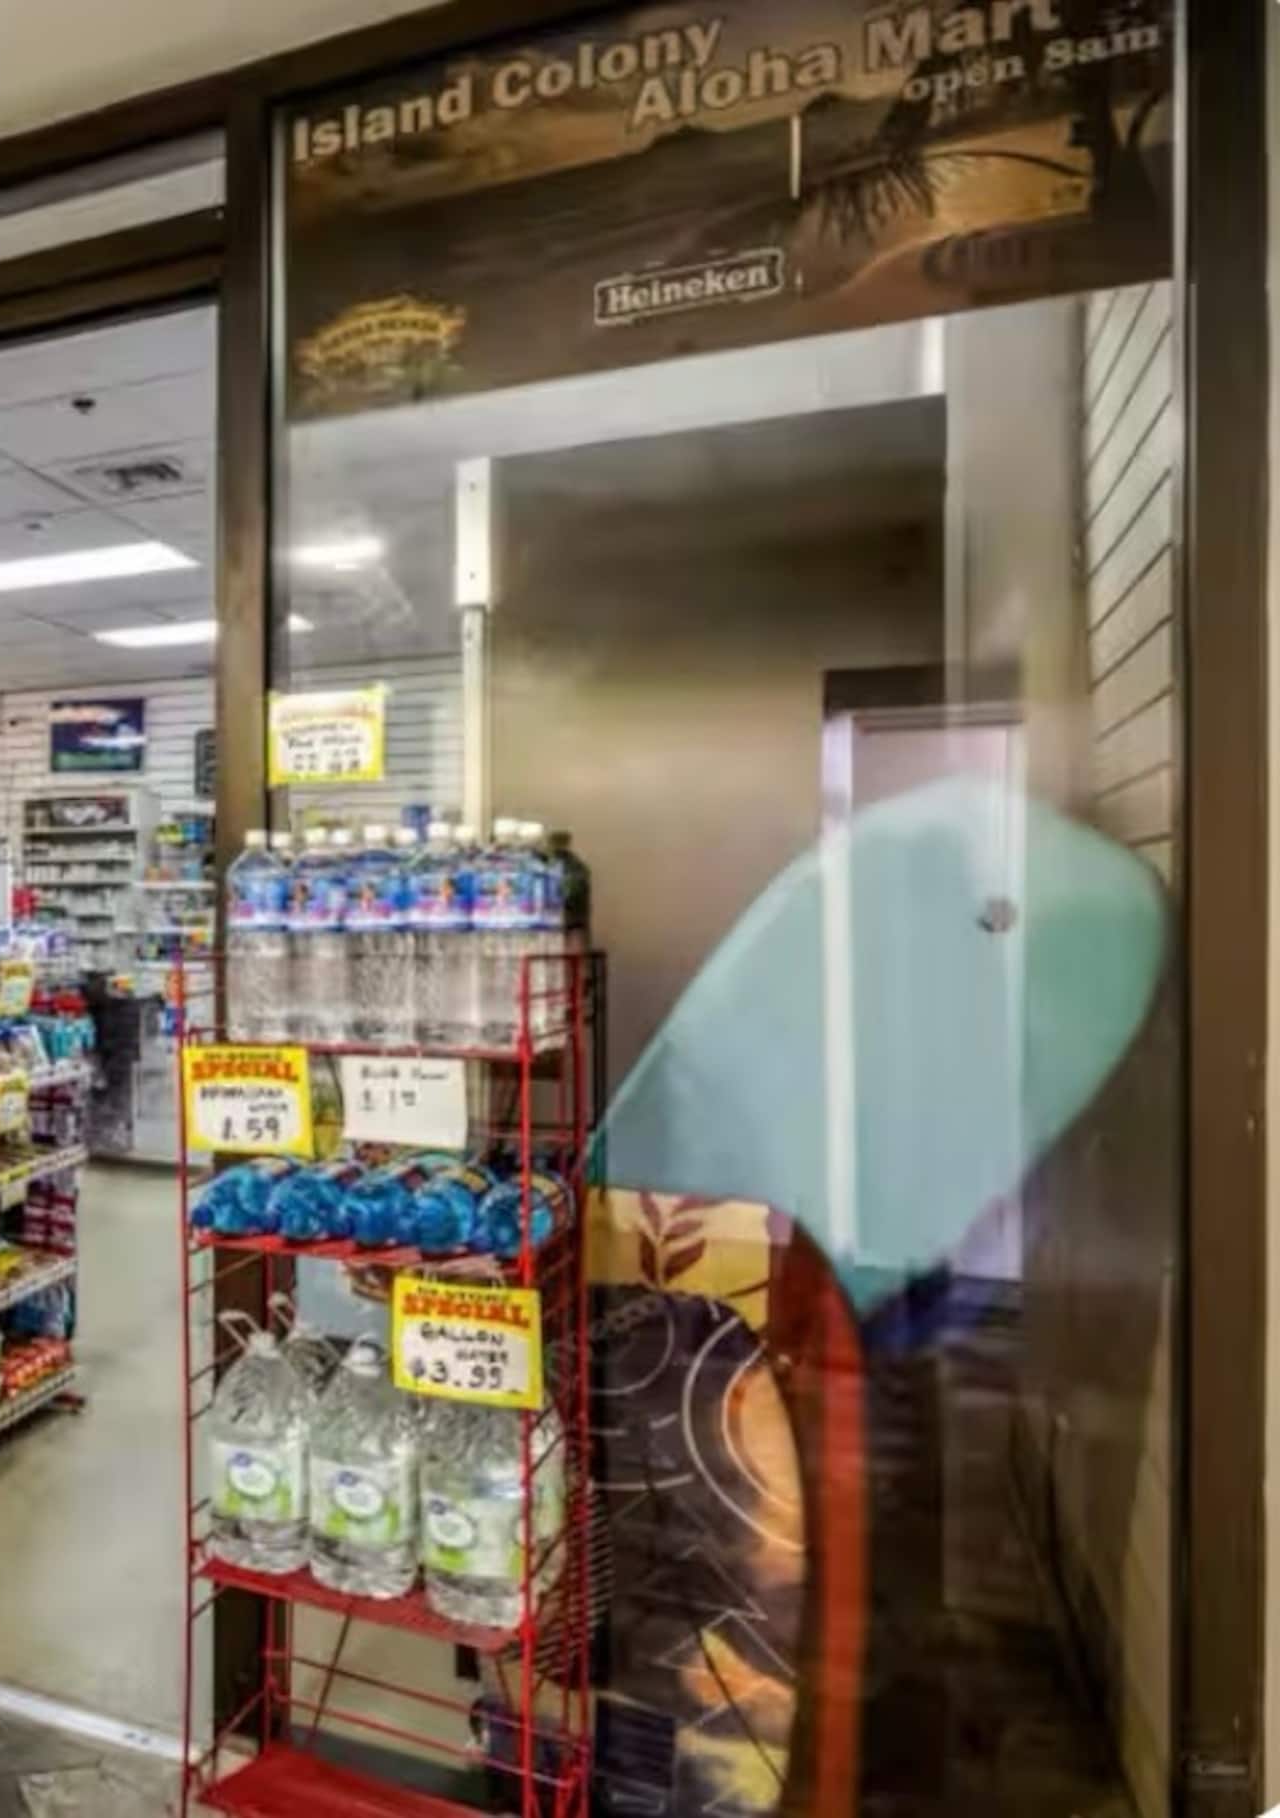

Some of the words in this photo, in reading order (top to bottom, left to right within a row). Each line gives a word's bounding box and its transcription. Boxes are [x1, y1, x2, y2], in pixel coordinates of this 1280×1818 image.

[631, 43, 840, 127] Aloha
[866, 0, 1060, 72] Mart
[903, 52, 1025, 106] open
[1043, 22, 1162, 71] 8am
[292, 73, 473, 162] Island
[492, 18, 721, 109] Colony
[606, 265, 769, 314] Heineken
[191, 1061, 299, 1083] SPECIAL
[403, 1294, 531, 1330] SPECIAL
[421, 1321, 504, 1346] GALLON
